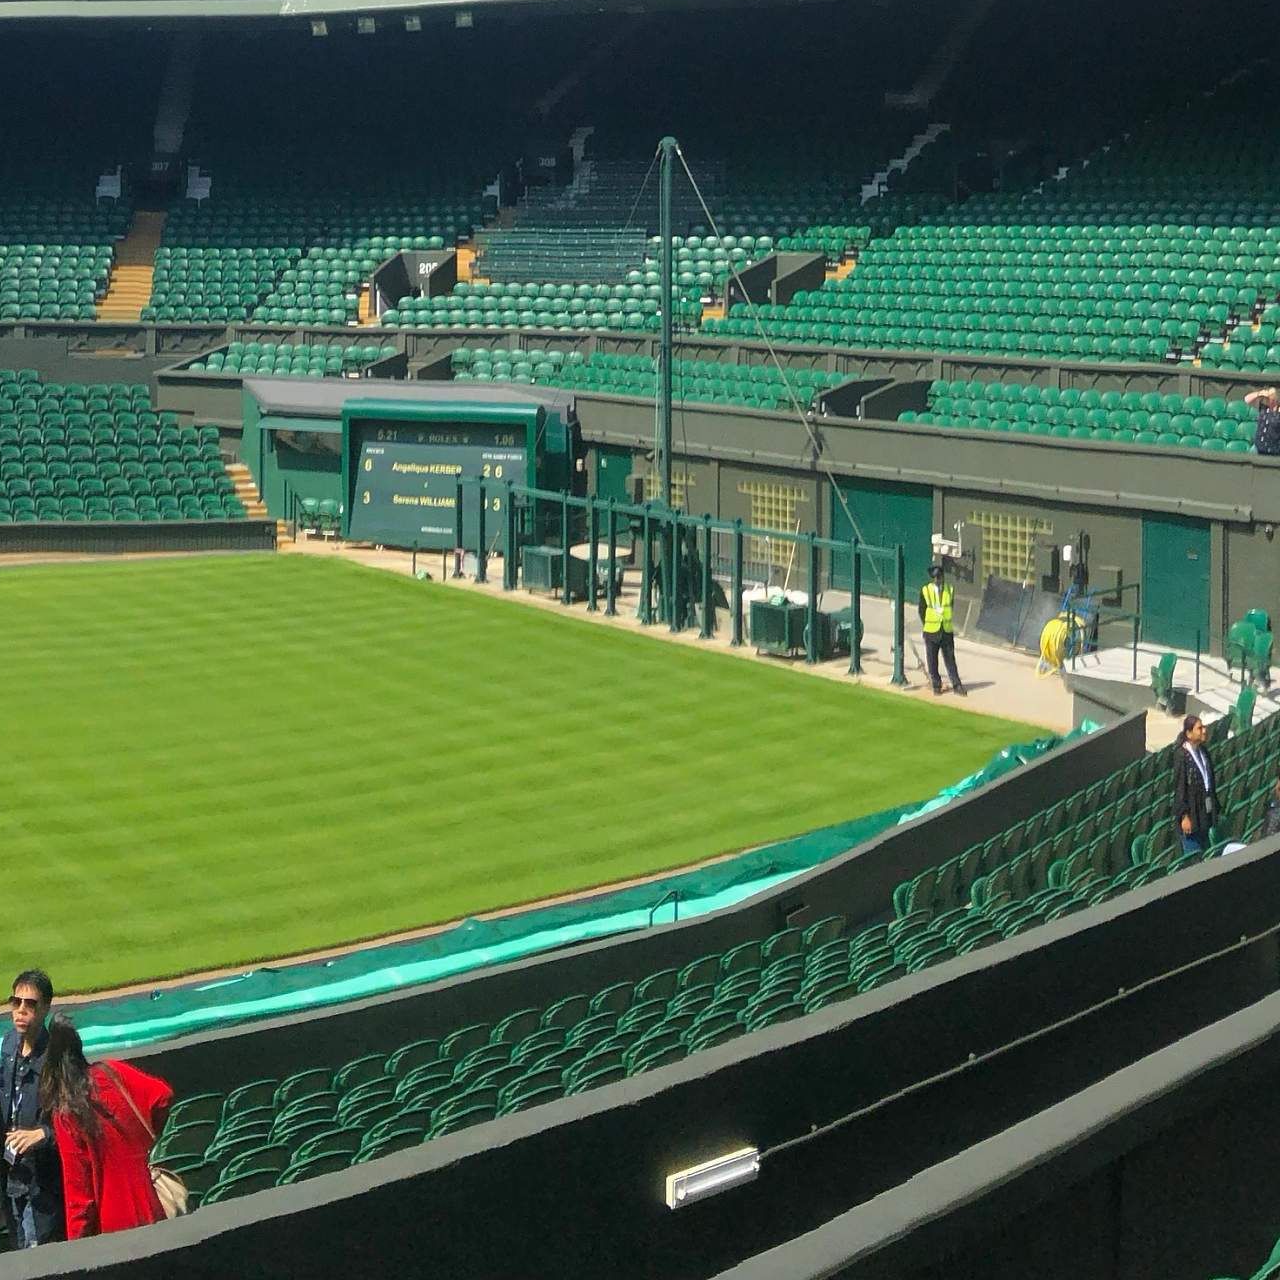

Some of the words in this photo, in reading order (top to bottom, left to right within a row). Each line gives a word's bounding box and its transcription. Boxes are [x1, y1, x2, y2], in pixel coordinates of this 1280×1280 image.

[392, 461, 429, 475] Angelique
[430, 463, 462, 475] KERBER
[483, 463, 491, 478] 2
[363, 490, 370, 504] 3
[393, 494, 419, 505] Serena
[493, 497, 501, 511] 3
